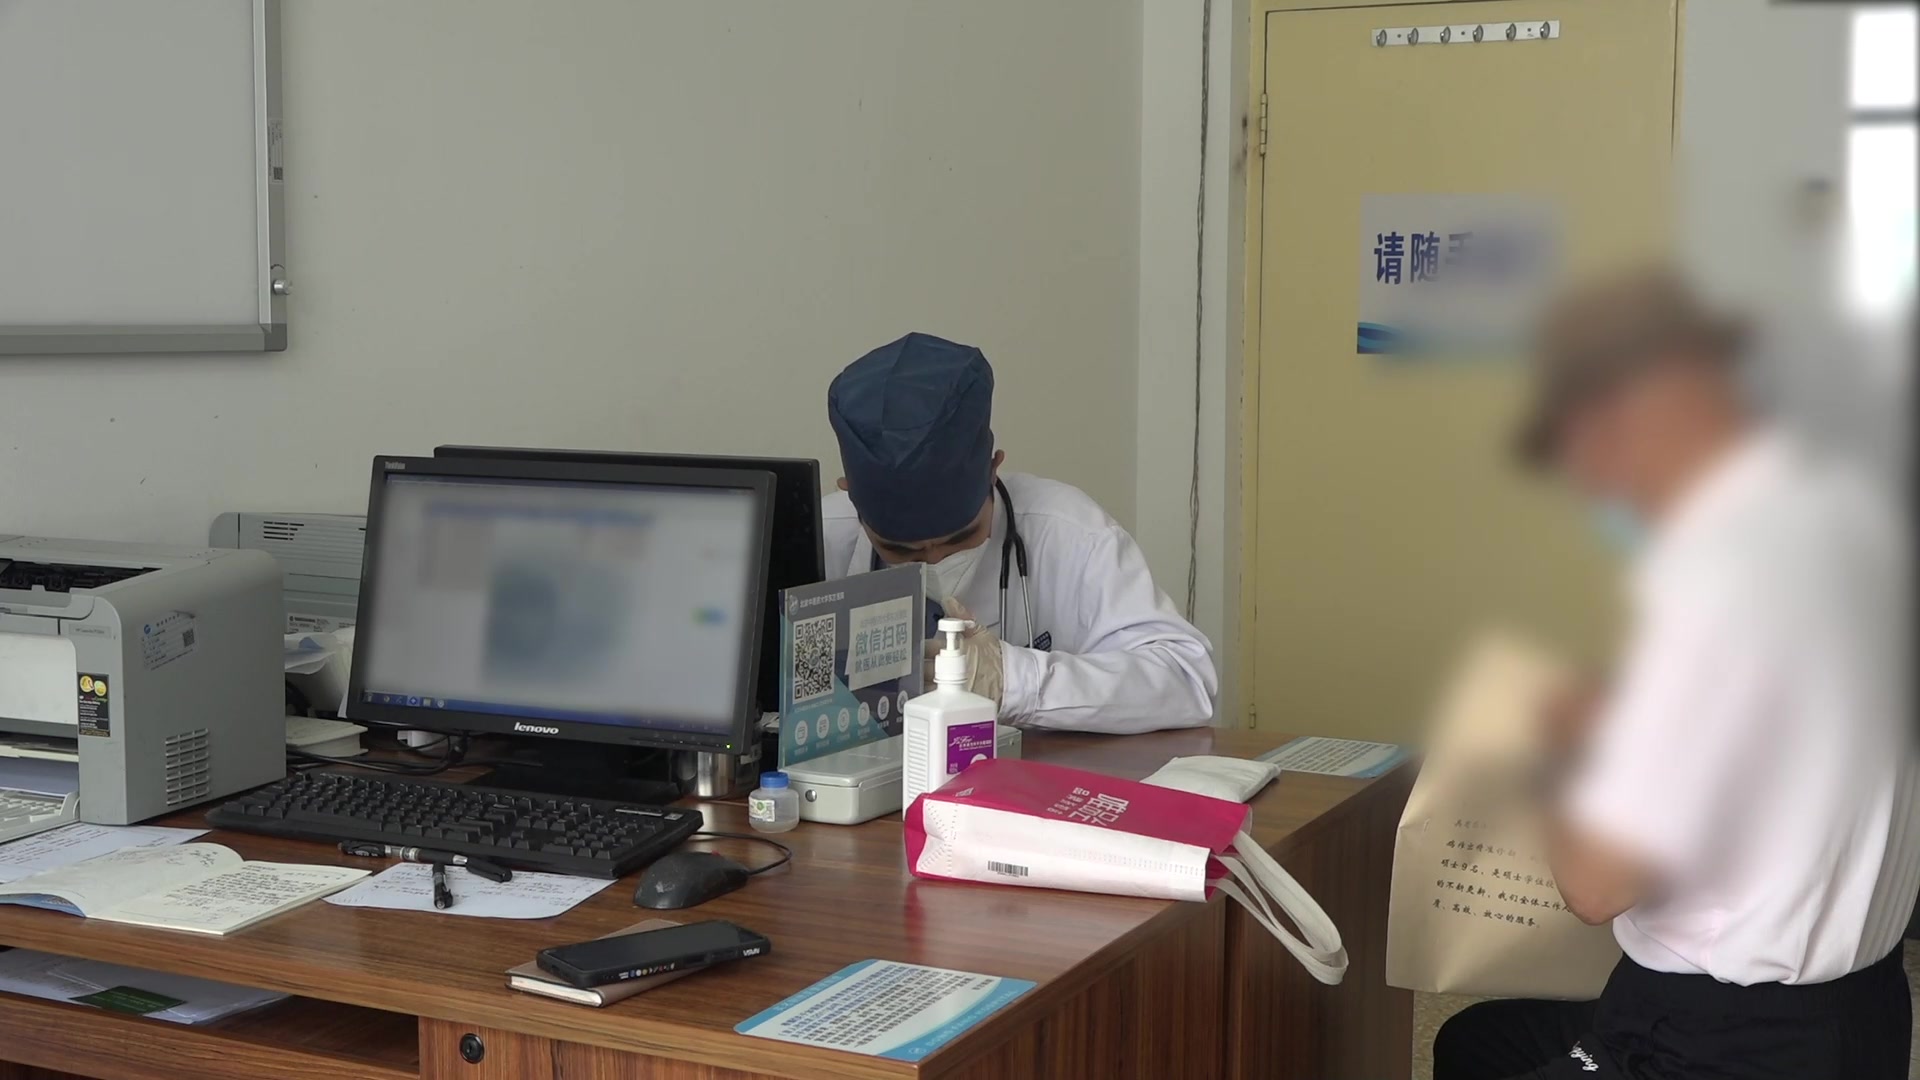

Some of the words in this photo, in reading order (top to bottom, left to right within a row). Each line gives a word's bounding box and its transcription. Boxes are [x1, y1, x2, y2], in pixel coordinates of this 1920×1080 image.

[855, 622, 908, 657] 微信扫码
[854, 648, 907, 674] 就医从此更轻松
[514, 721, 559, 735] lenovo
